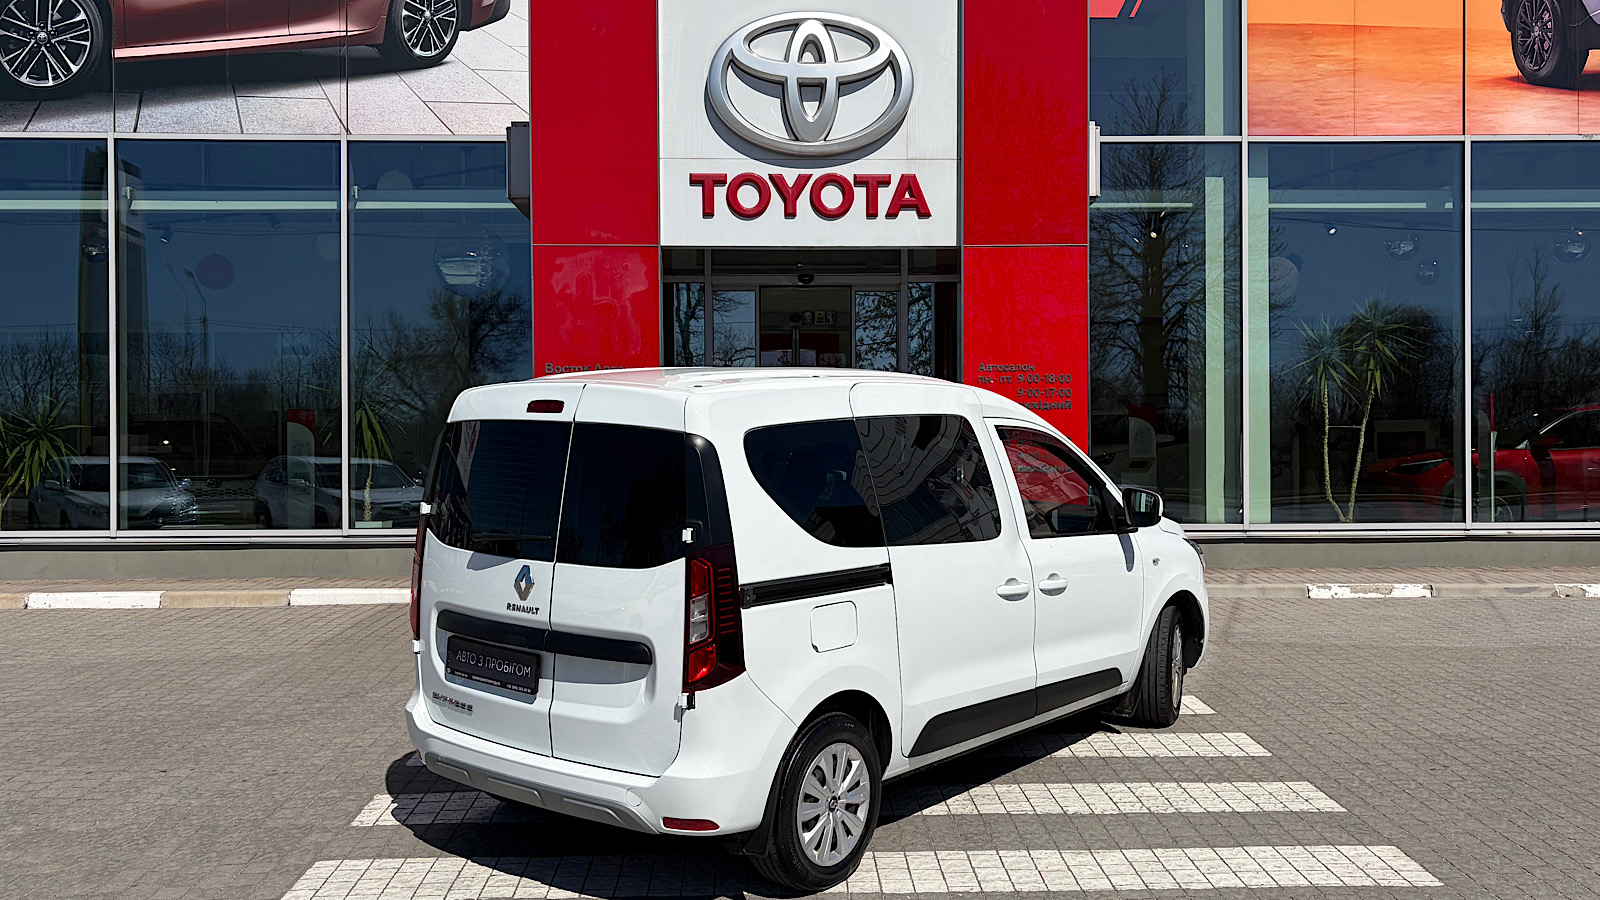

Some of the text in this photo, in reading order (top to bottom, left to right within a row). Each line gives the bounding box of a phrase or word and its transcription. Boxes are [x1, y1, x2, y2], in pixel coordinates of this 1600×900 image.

[689, 173, 932, 219] TOYOTA
[978, 363, 1035, 373] Автосалон
[1017, 374, 1072, 384] 9:00-18:00
[1017, 388, 1072, 398] 9:00-17:00
[506, 602, 540, 615] RENAULT
[456, 650, 477, 665] АВТО
[485, 657, 531, 678] ПРОБІГОМ
